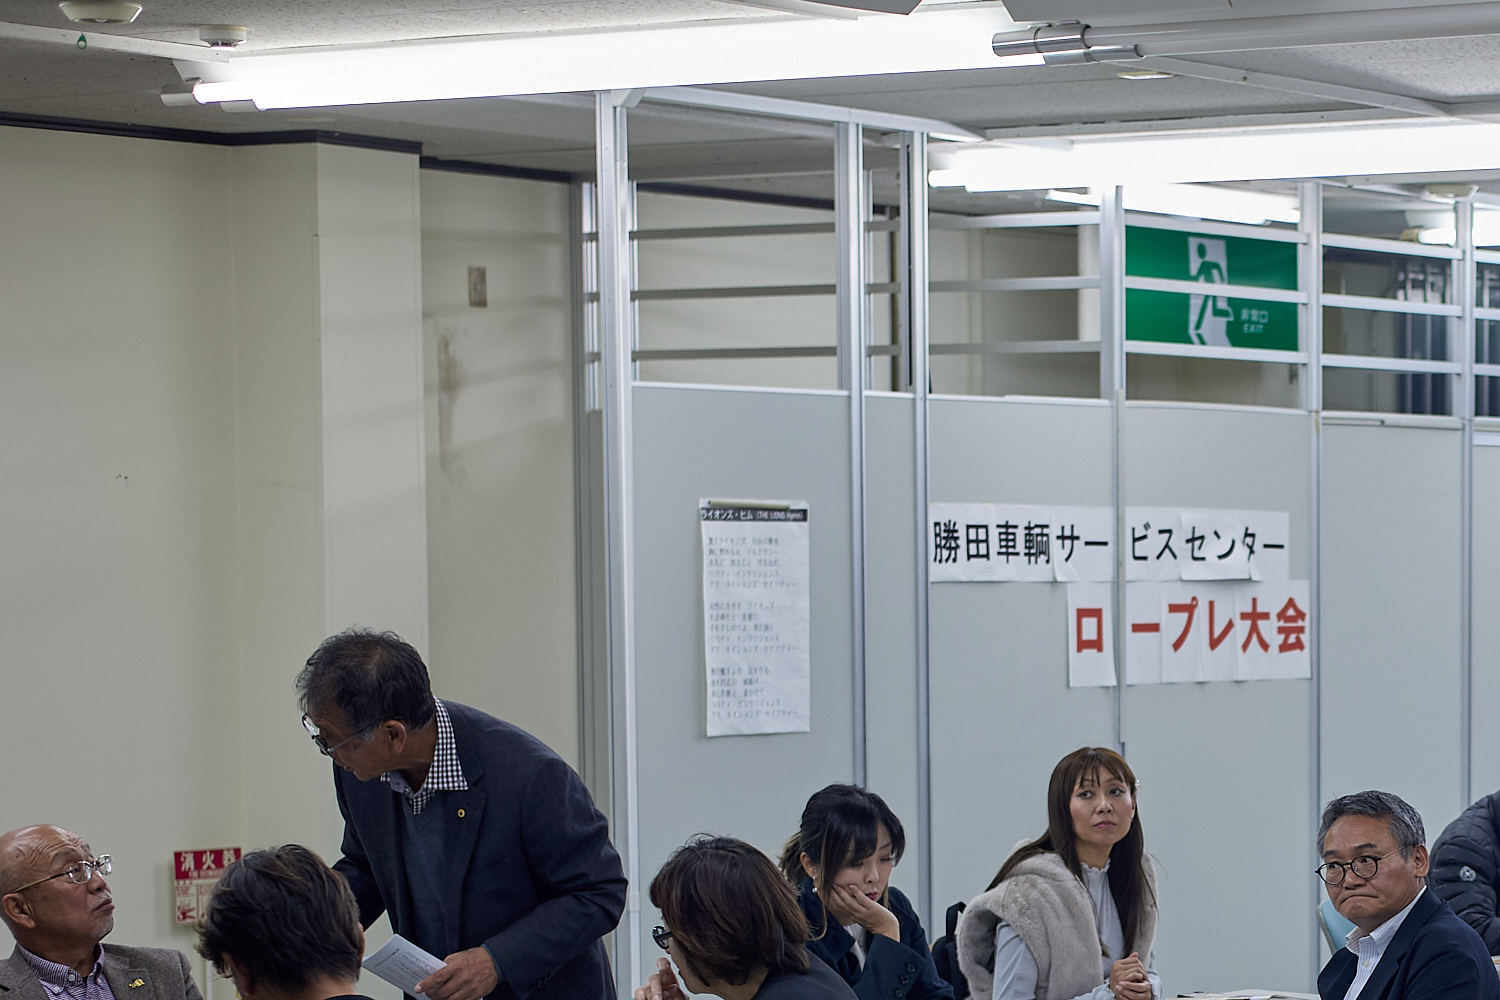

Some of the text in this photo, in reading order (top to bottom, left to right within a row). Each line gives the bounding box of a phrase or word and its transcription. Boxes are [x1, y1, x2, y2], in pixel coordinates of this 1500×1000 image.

[1240, 308, 1268, 323] 非常口
[1243, 323, 1263, 333] EXIT
[1076, 595, 1307, 654] ロープレ大会
